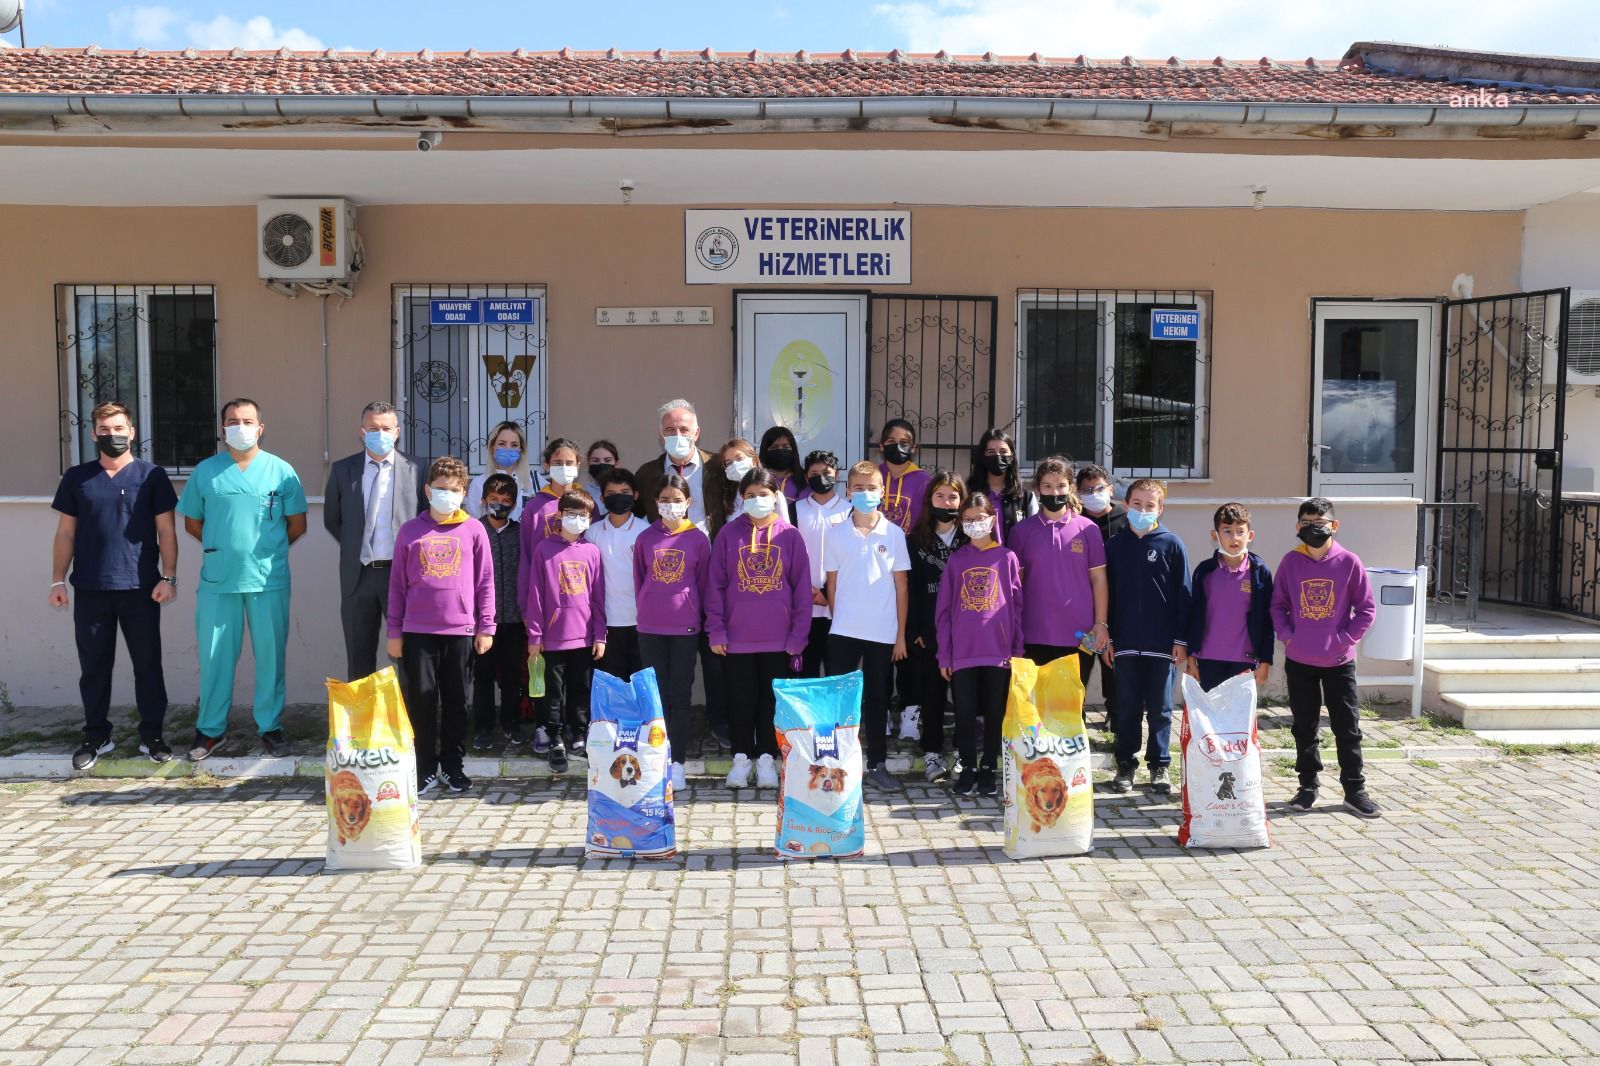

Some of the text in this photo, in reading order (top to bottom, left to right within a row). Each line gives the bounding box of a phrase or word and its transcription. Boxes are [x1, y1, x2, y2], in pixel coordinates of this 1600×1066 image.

[320, 208, 335, 252] arçelik
[438, 303, 472, 311] MUAYENE
[445, 312, 466, 321] ODASI
[497, 312, 520, 321] ODASI
[618, 726, 639, 737] PAW
[616, 737, 636, 747] PAW
[816, 730, 834, 744] PAW
[816, 743, 834, 756] PAW
[1206, 738, 1248, 755] Bddy
[655, 808, 665, 817] Kg
